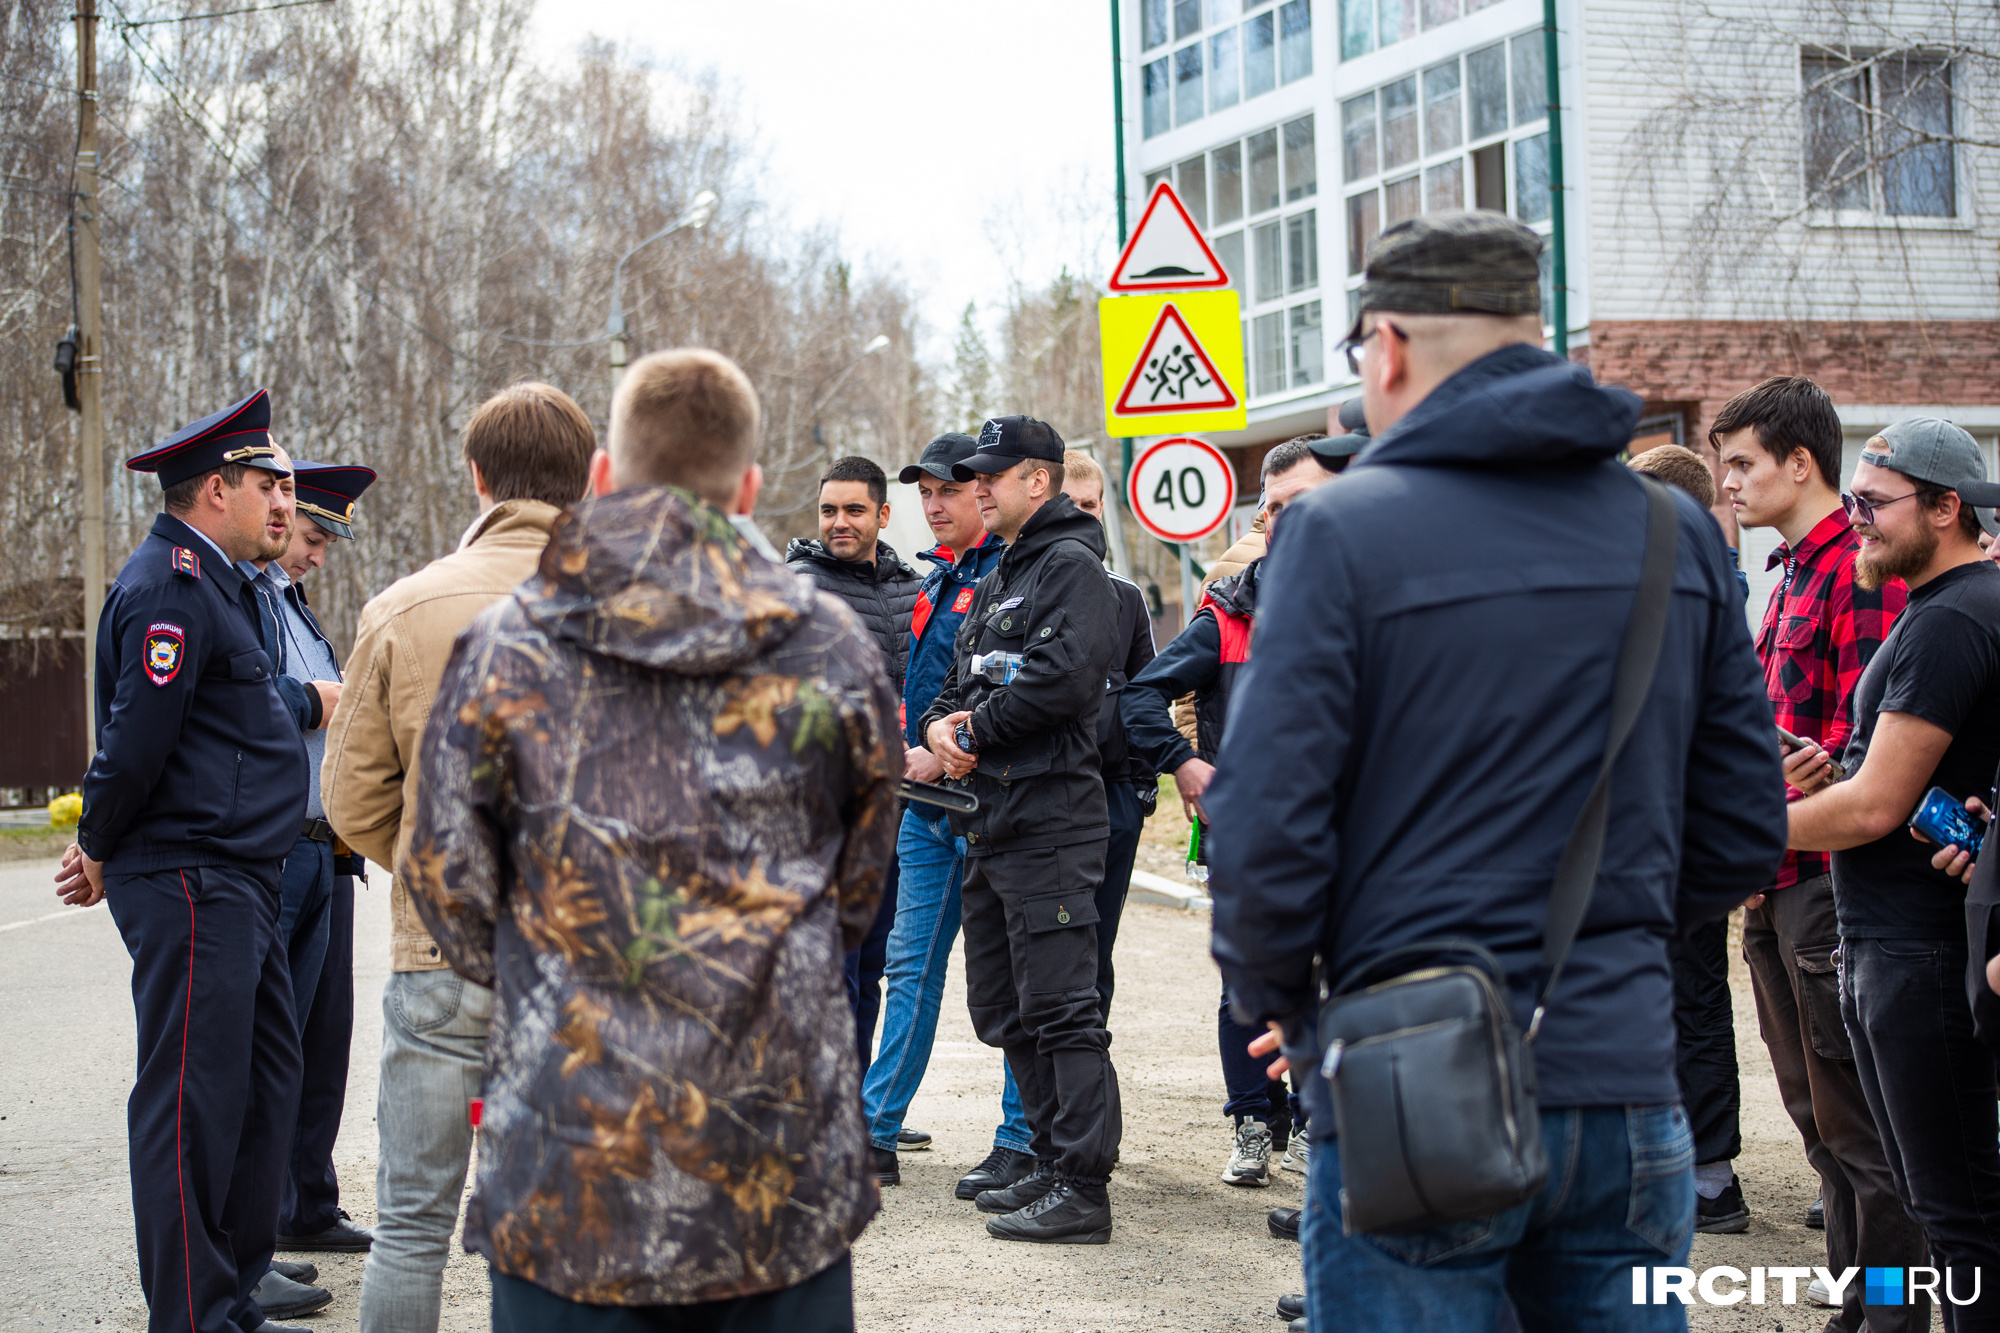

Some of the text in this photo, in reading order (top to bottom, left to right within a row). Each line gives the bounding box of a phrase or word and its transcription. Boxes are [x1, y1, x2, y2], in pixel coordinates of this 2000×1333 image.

[1154, 467, 1206, 511] 40
[150, 623, 183, 636] ПОЛИЦИЯ
[153, 673, 168, 685] МВД
